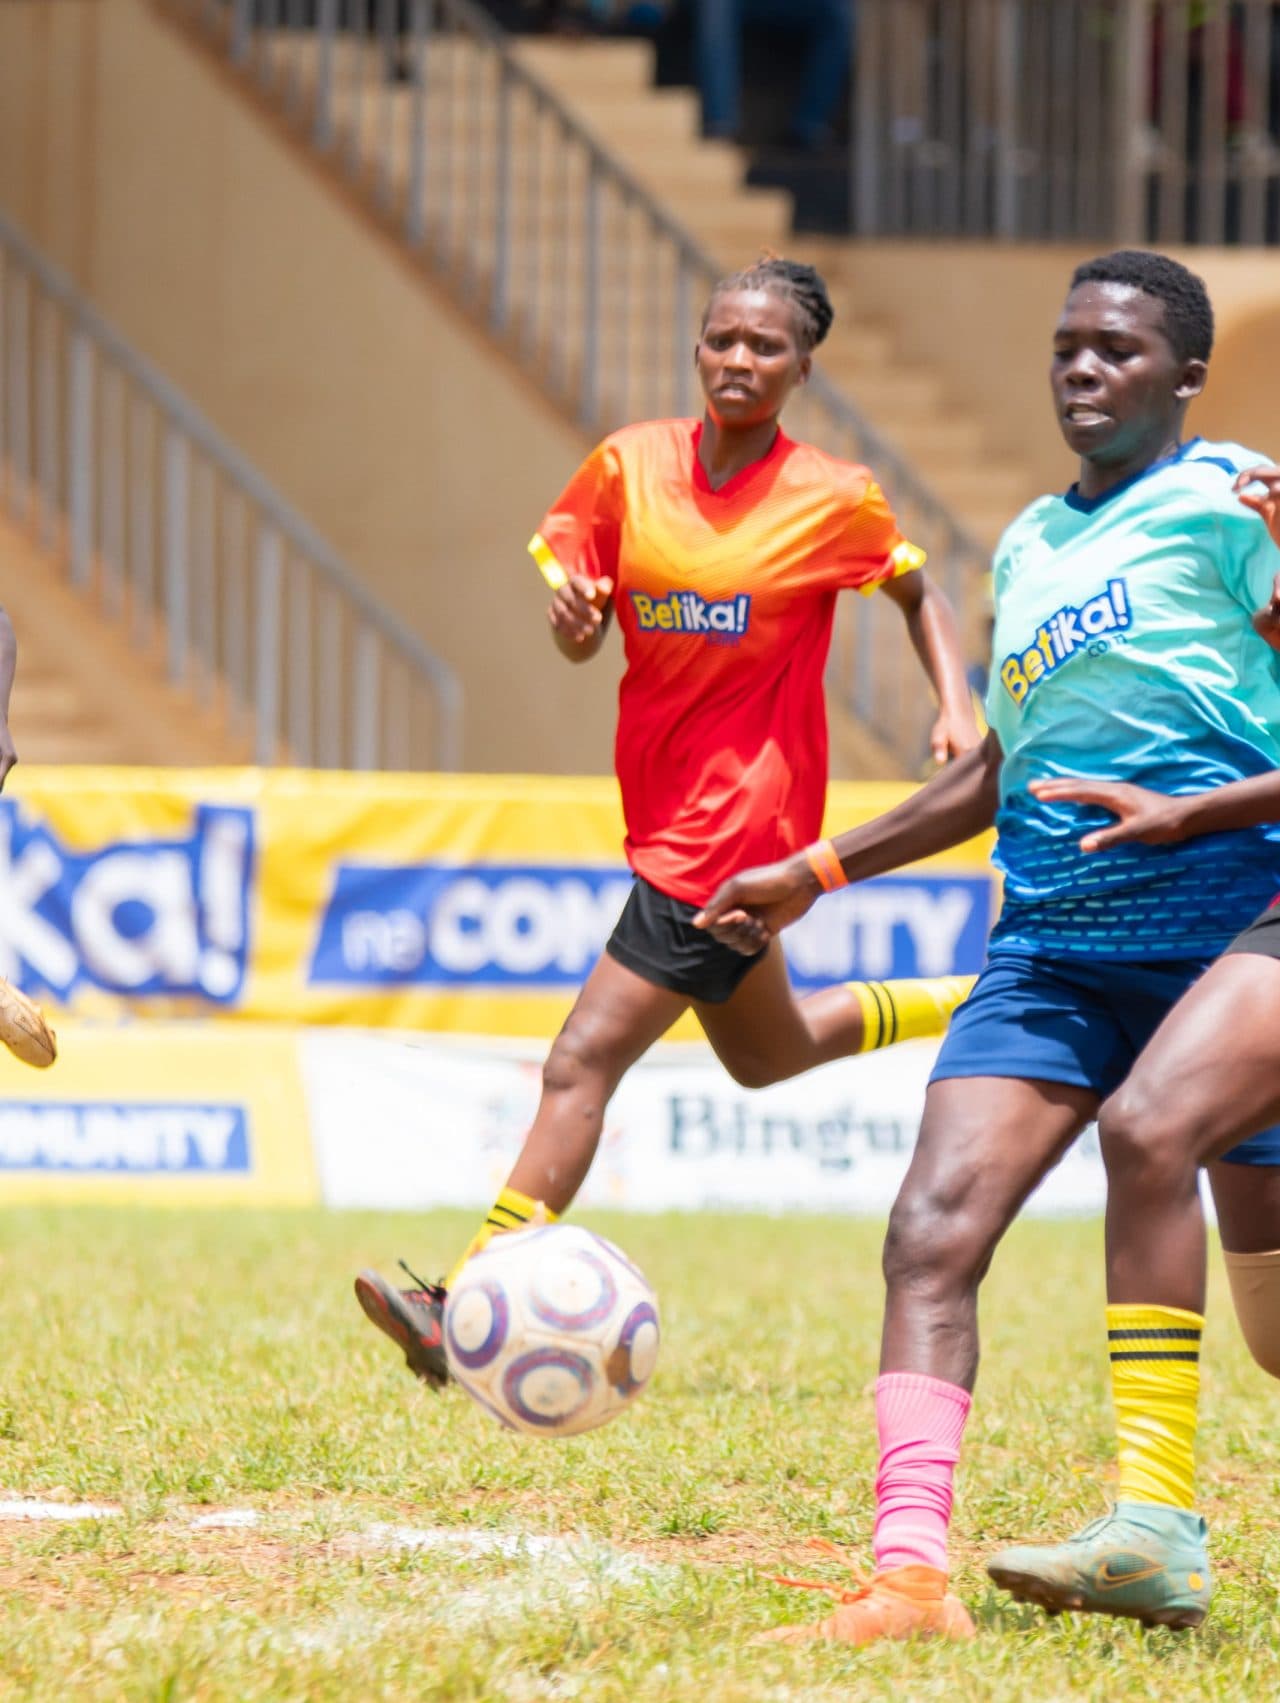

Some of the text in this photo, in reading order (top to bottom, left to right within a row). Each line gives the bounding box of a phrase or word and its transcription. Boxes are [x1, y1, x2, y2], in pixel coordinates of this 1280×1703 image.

[632, 595, 748, 633] Betika!
[1001, 580, 1129, 702] Betika!
[429, 876, 975, 975] COMNITY
